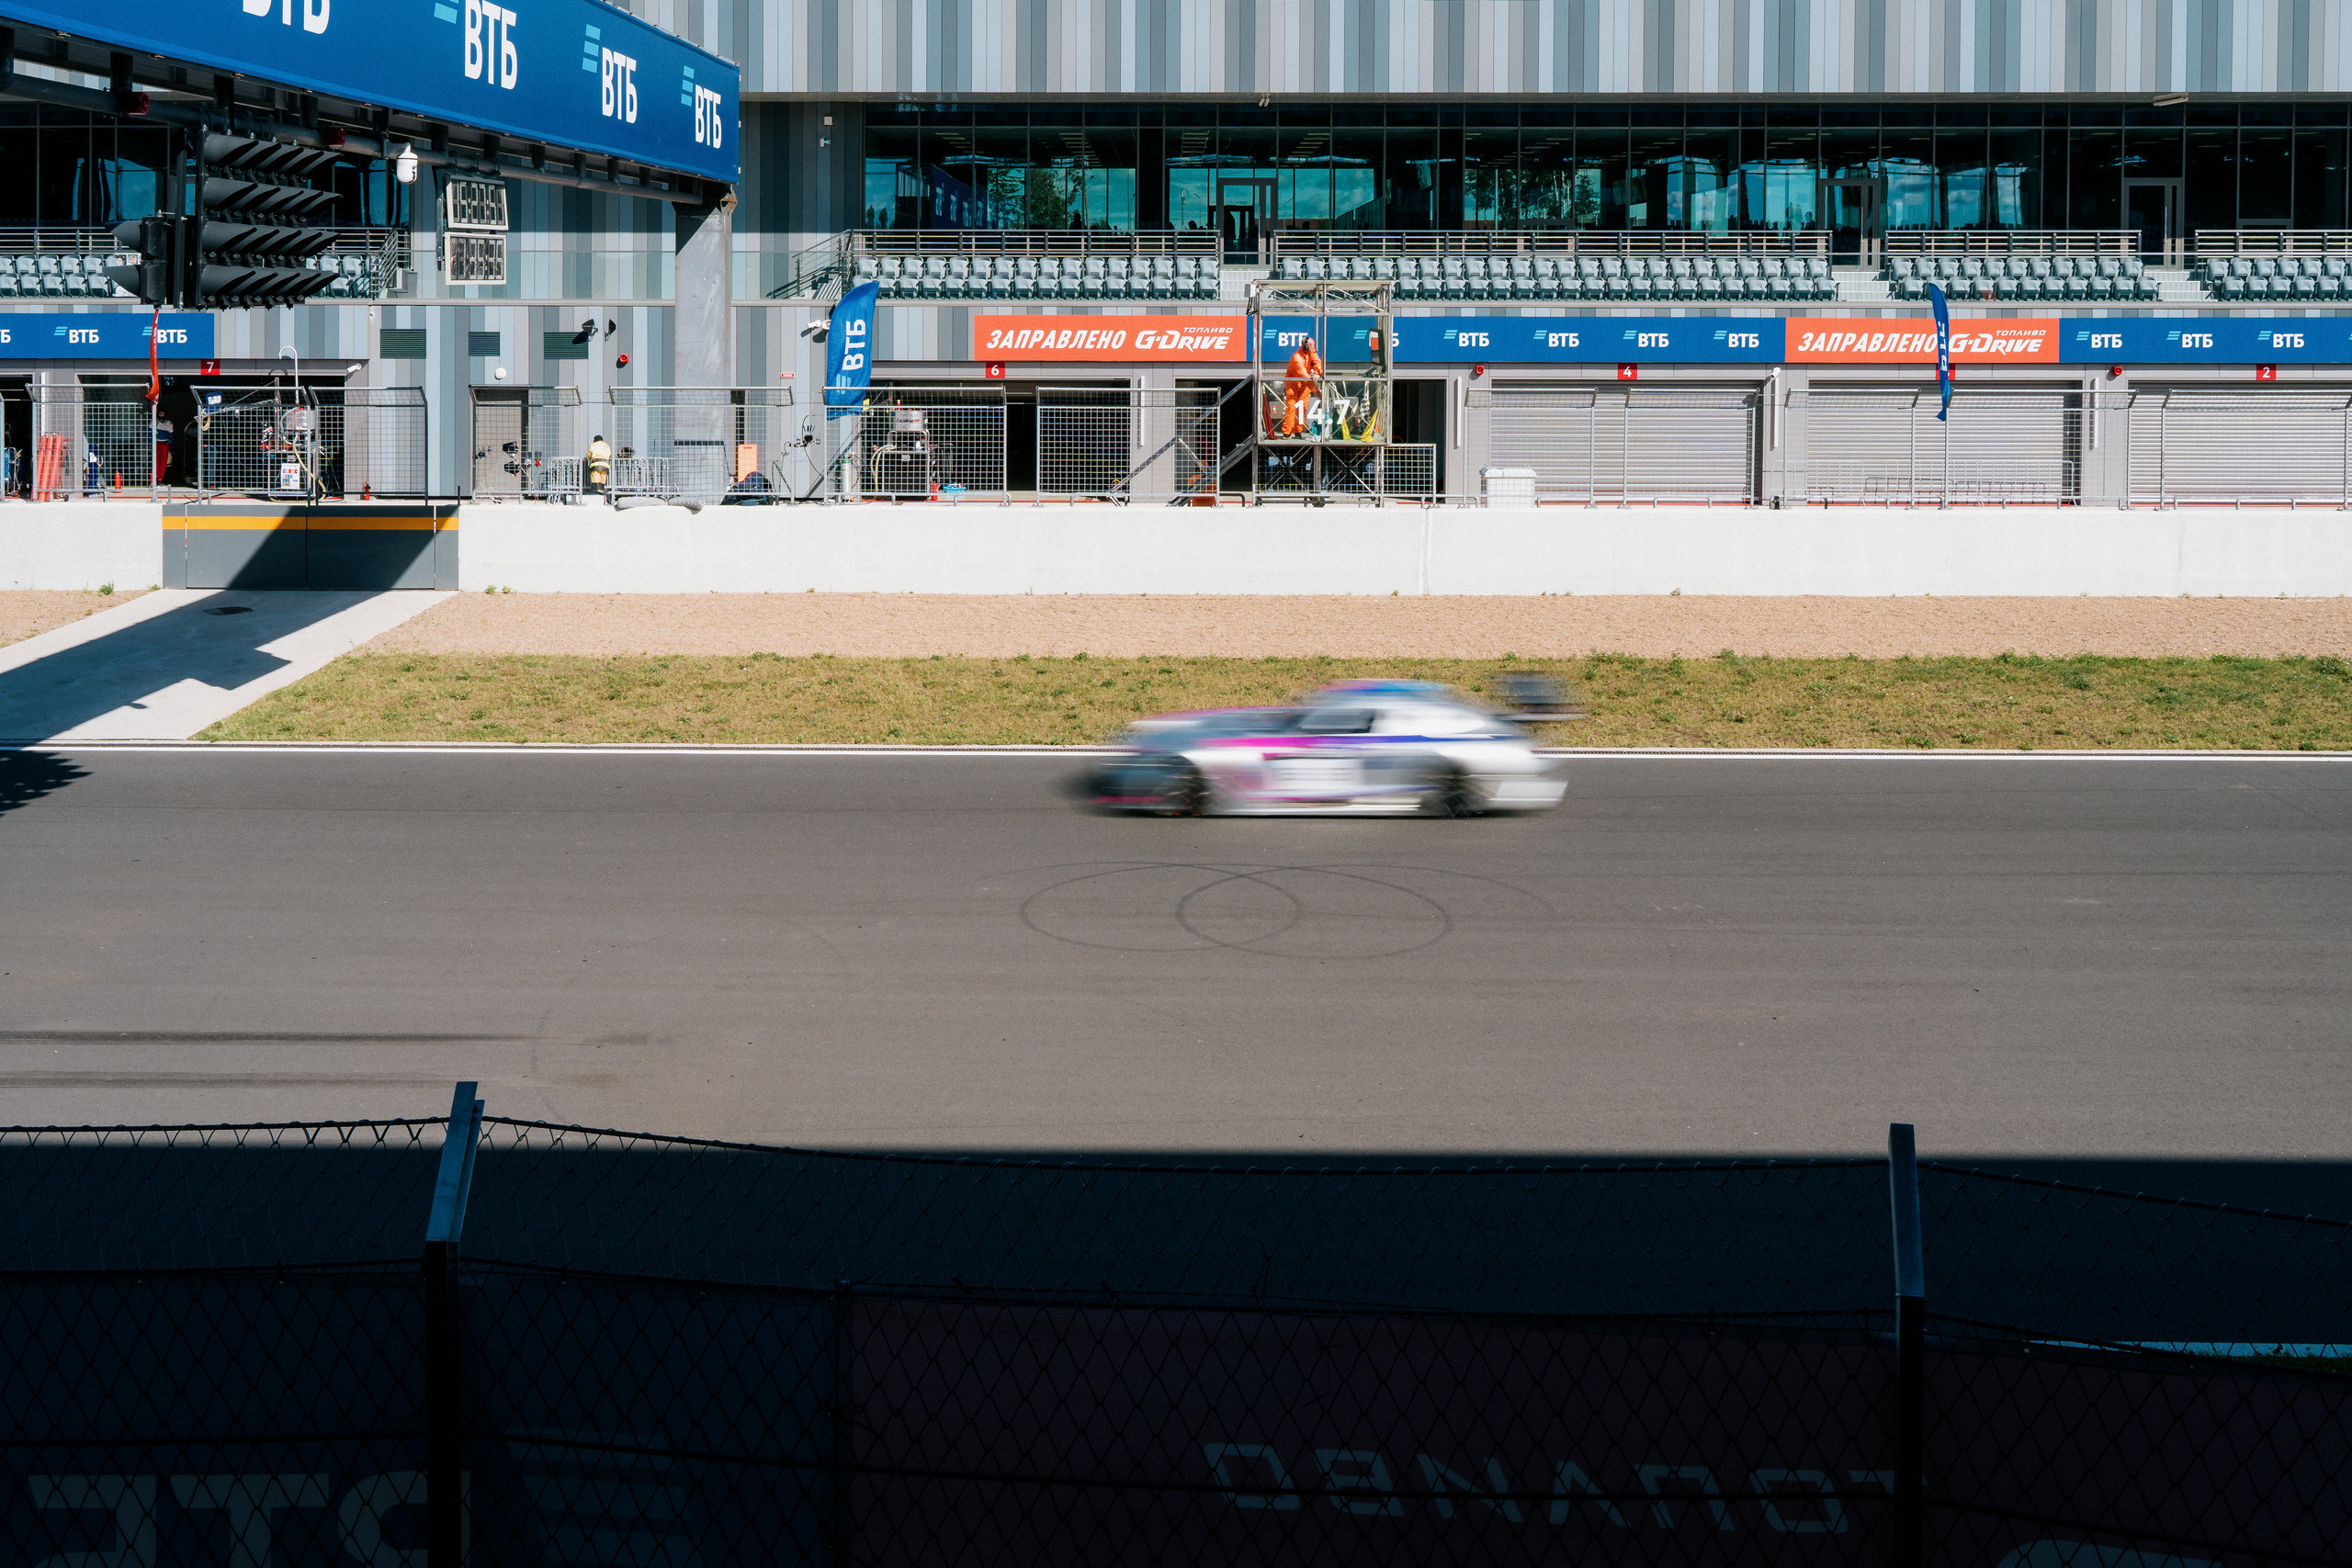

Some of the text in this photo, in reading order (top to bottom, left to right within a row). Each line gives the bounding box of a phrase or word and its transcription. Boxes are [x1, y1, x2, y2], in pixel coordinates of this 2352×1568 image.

[465, 0, 518, 90] ВТБ
[602, 47, 639, 124] ВТБ
[695, 84, 722, 149] ВТБ
[69, 329, 100, 344] ВТБ
[157, 329, 187, 344] ВТБ
[986, 329, 1127, 350] ЗАПРАВЛЕНО
[1458, 332, 1489, 348] ВТБ
[1548, 332, 1579, 348] ВТБ
[1638, 332, 1669, 348] ВТБ
[1728, 332, 1759, 348] ВТБ
[1797, 332, 1938, 354] ЗАПРАВЛЕНО
[2091, 333, 2122, 348] ВТБ
[2181, 333, 2212, 348] ВТБ
[2273, 333, 2304, 348] ВТБ
[842, 319, 867, 371] ВТБ
[207, 361, 215, 373] 7
[991, 365, 1000, 376] 6
[1623, 366, 1633, 378] 4
[2262, 367, 2270, 378] 2
[1294, 399, 1351, 425] 14.7
